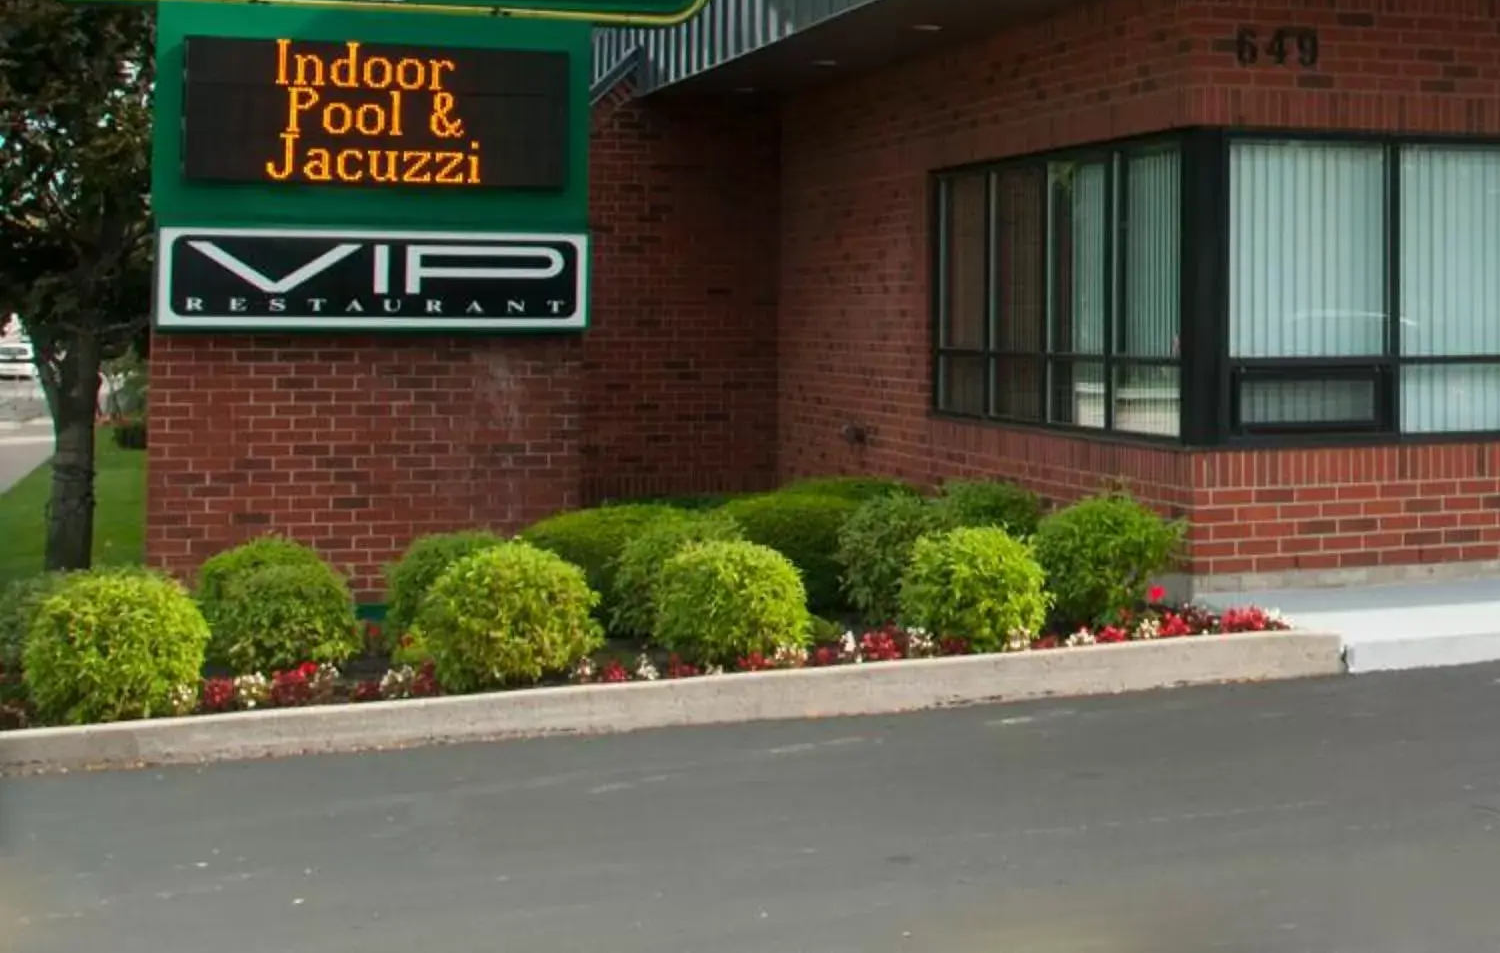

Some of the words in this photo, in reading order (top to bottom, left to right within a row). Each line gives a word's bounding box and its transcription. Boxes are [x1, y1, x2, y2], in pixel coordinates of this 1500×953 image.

[274, 37, 455, 91] Indoor
[1236, 23, 1319, 67] 649
[284, 86, 404, 137] Pool
[429, 91, 465, 138] &
[264, 133, 482, 185] Jacuzzi
[185, 239, 566, 296] VIP
[184, 296, 565, 315] RESTAURANT
